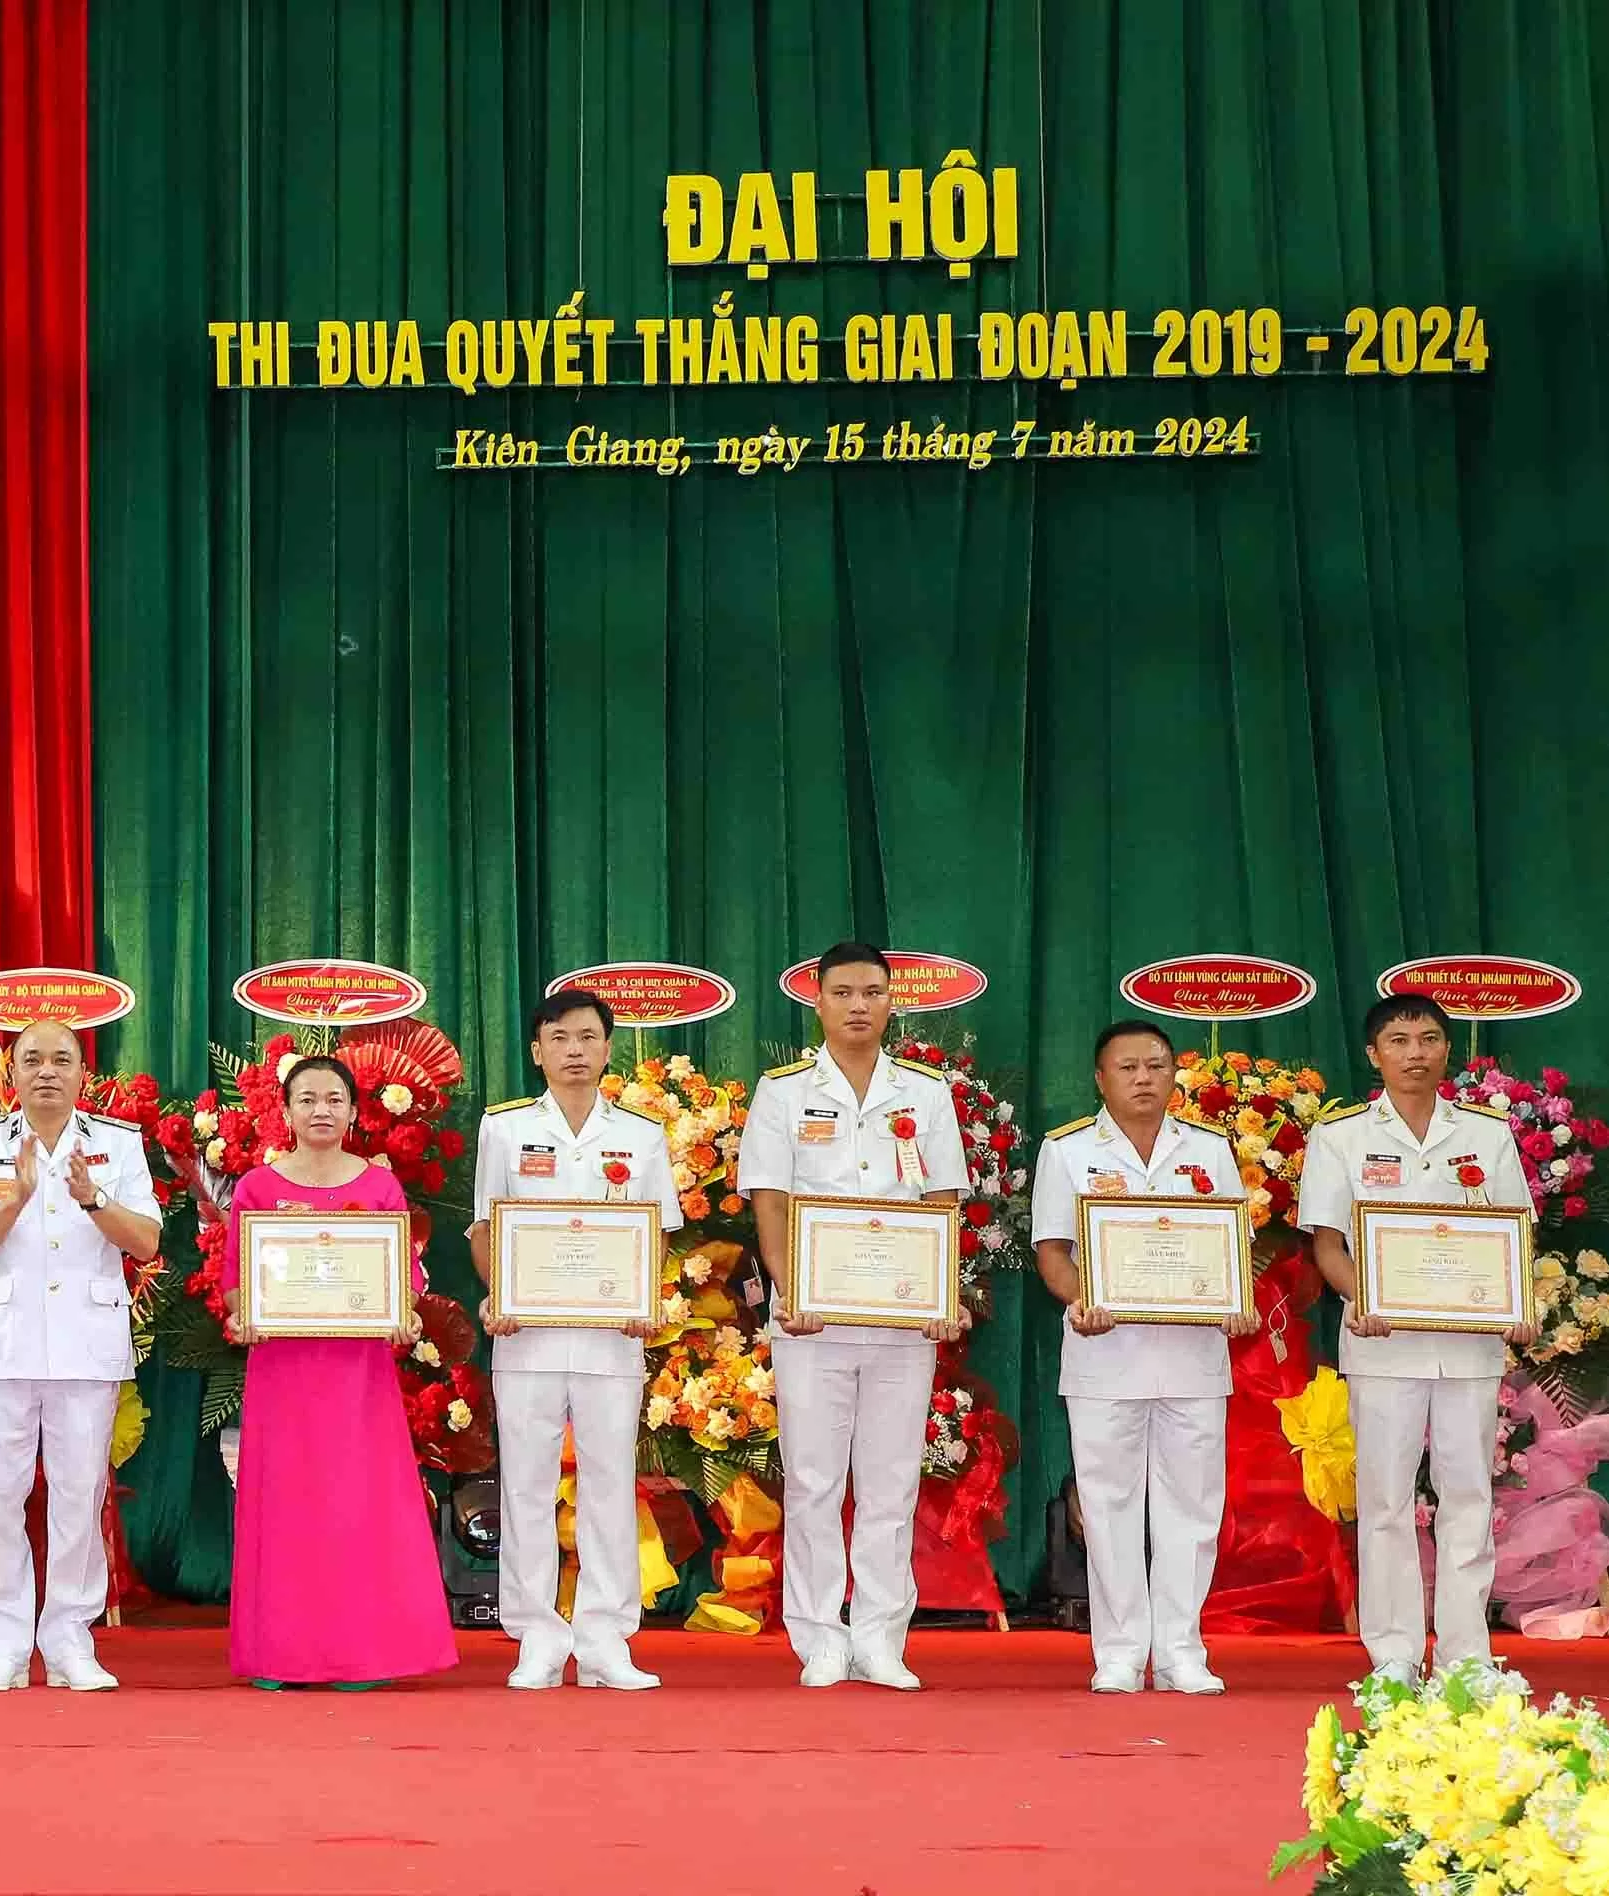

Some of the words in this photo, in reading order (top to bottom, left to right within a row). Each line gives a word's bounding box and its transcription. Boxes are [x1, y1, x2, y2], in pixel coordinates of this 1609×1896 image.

[663, 172, 817, 280] ĐẠI
[865, 150, 1017, 279] HỘI
[208, 321, 289, 386] THI
[317, 320, 425, 388] ĐUA
[446, 291, 614, 395] QUYẾT
[636, 291, 818, 384] THẮNG
[845, 313, 952, 381] GIAI
[978, 311, 1127, 390] ĐOẠN
[1153, 308, 1282, 378] 2019
[1306, 336, 1329, 352] -
[1345, 306, 1489, 376] 2024
[454, 429, 538, 470] Kiên
[566, 425, 690, 476] Giang,
[714, 424, 811, 476] ngày
[823, 424, 867, 461] 15
[882, 418, 996, 470] tháng
[1011, 420, 1035, 456] 7
[1049, 418, 1136, 457] năm
[1154, 416, 1248, 455] 2024
